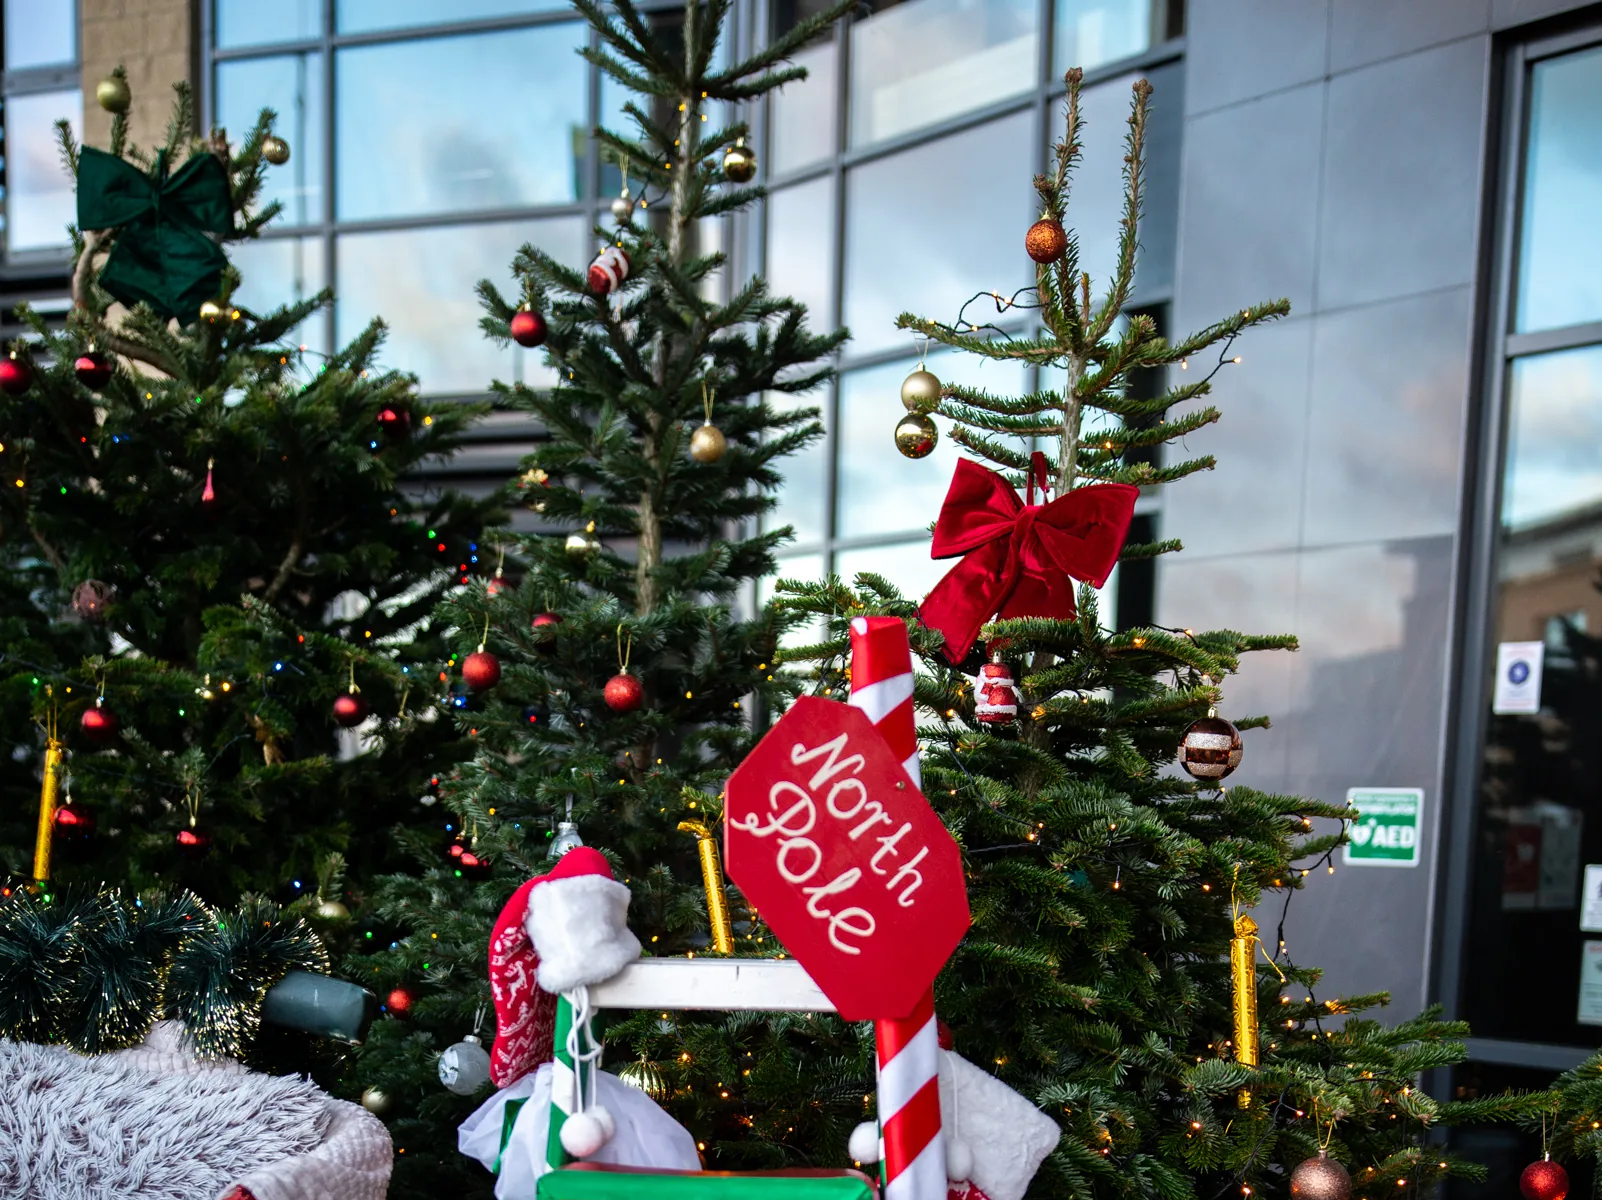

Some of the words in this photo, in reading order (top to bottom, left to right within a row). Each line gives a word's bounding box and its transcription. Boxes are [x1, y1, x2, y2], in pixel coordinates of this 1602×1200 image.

[730, 780, 876, 955] Pole
[791, 732, 929, 908] North
[1371, 824, 1415, 849] AED
